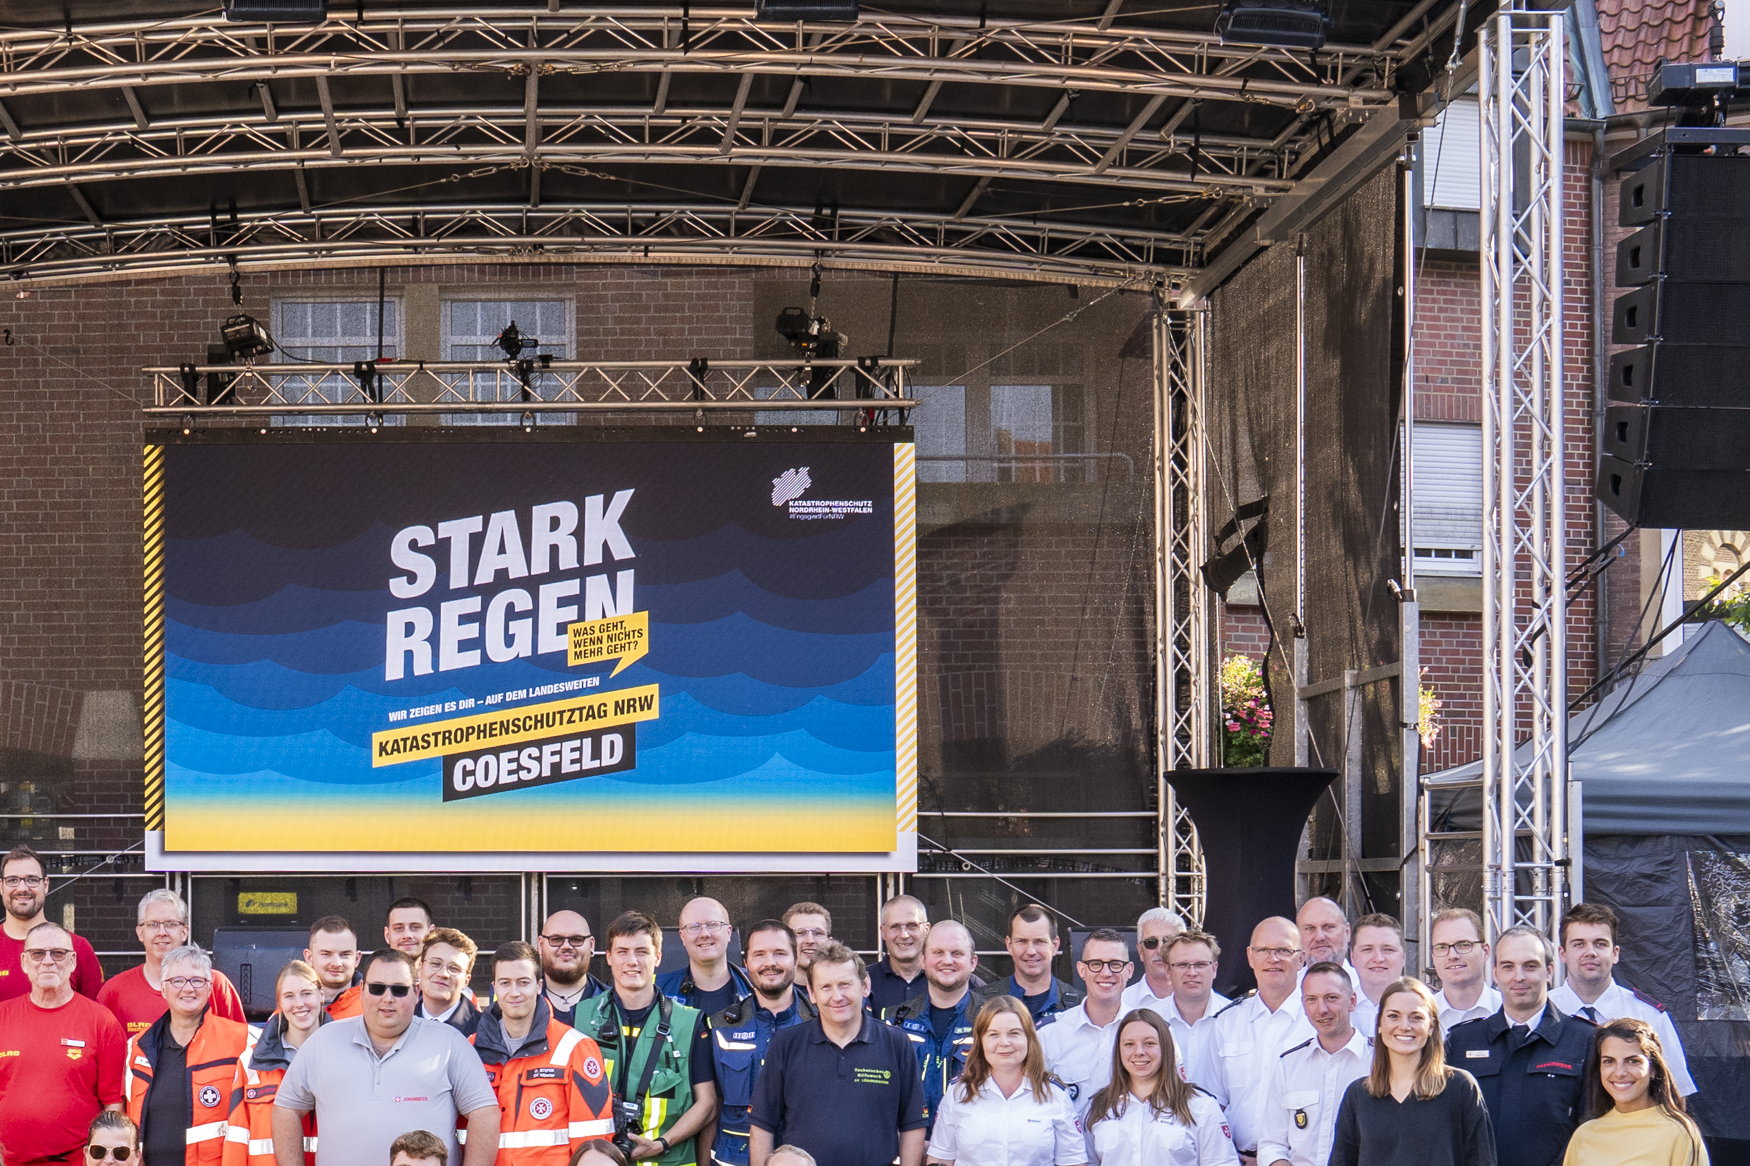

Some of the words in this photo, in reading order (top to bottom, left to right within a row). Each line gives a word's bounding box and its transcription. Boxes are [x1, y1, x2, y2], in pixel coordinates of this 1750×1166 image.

[388, 488, 636, 599] STARK
[385, 568, 635, 682] REGEN
[573, 625, 595, 638] WAS
[598, 620, 626, 634] GEHT,
[573, 635, 603, 649] WENN
[606, 628, 643, 643] NICHTS
[573, 646, 603, 660] MEHR
[606, 640, 639, 655] GEHT?
[388, 709, 407, 722] WIR
[409, 704, 442, 719] ZEIGEN
[444, 702, 457, 713] ES
[458, 698, 475, 711] DIR
[485, 693, 504, 706] AUF
[505, 688, 527, 702] DEM
[528, 676, 600, 698] LANDESWEITEN
[378, 702, 608, 758] KATASTROPHENSCHUTZTAG
[614, 694, 655, 717] NRW
[452, 733, 624, 792] COESFELD
[1536, 1061, 1572, 1070] FEUERWEHR
